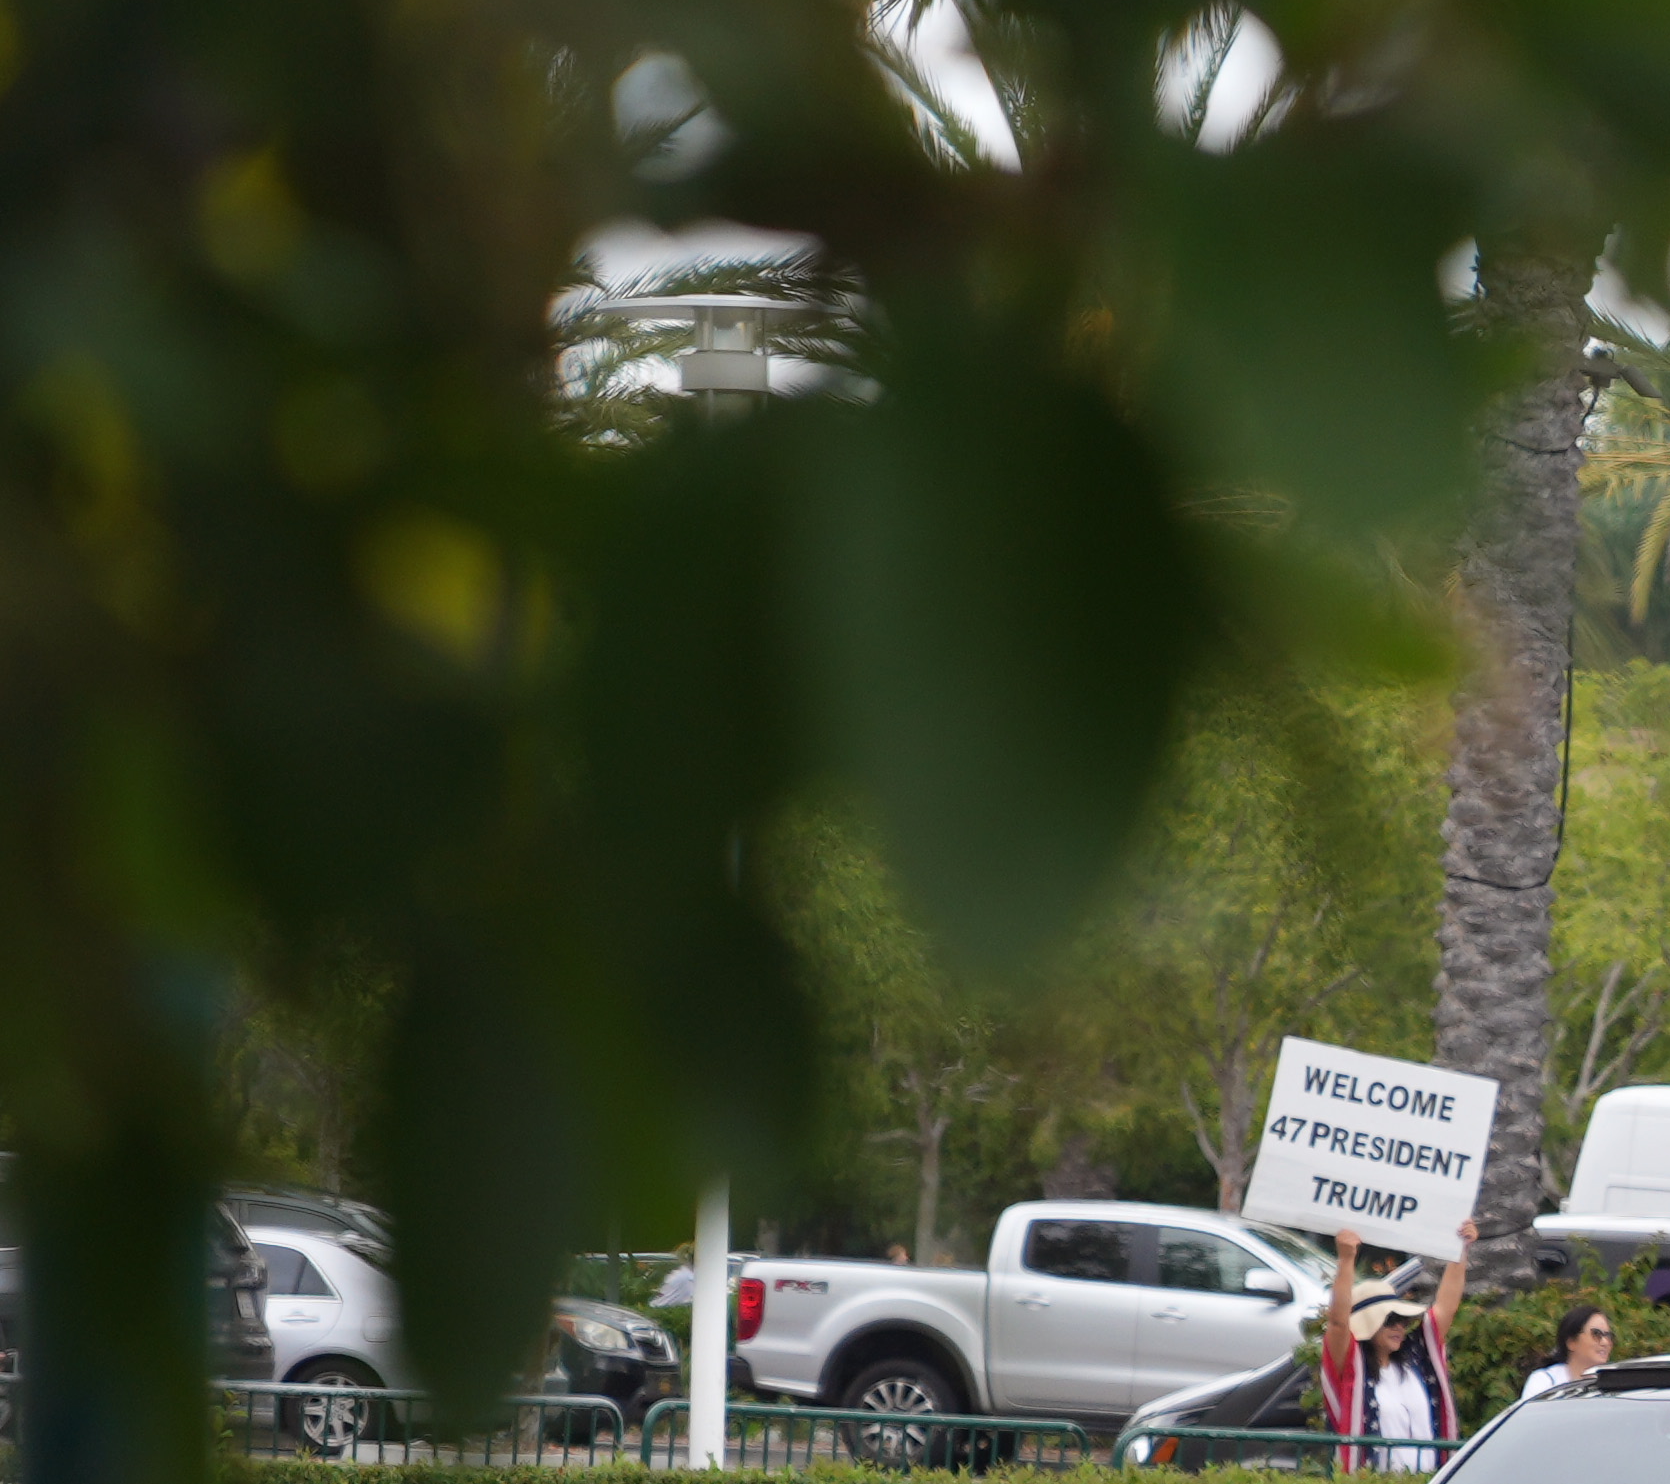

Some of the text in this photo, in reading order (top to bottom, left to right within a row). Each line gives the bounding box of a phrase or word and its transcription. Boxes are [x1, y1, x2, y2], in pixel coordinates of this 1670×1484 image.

[1303, 1065, 1456, 1123] WELCOME
[1269, 1114, 1472, 1181] 47 PRESIDENT
[1312, 1175, 1419, 1221] TRUMP
